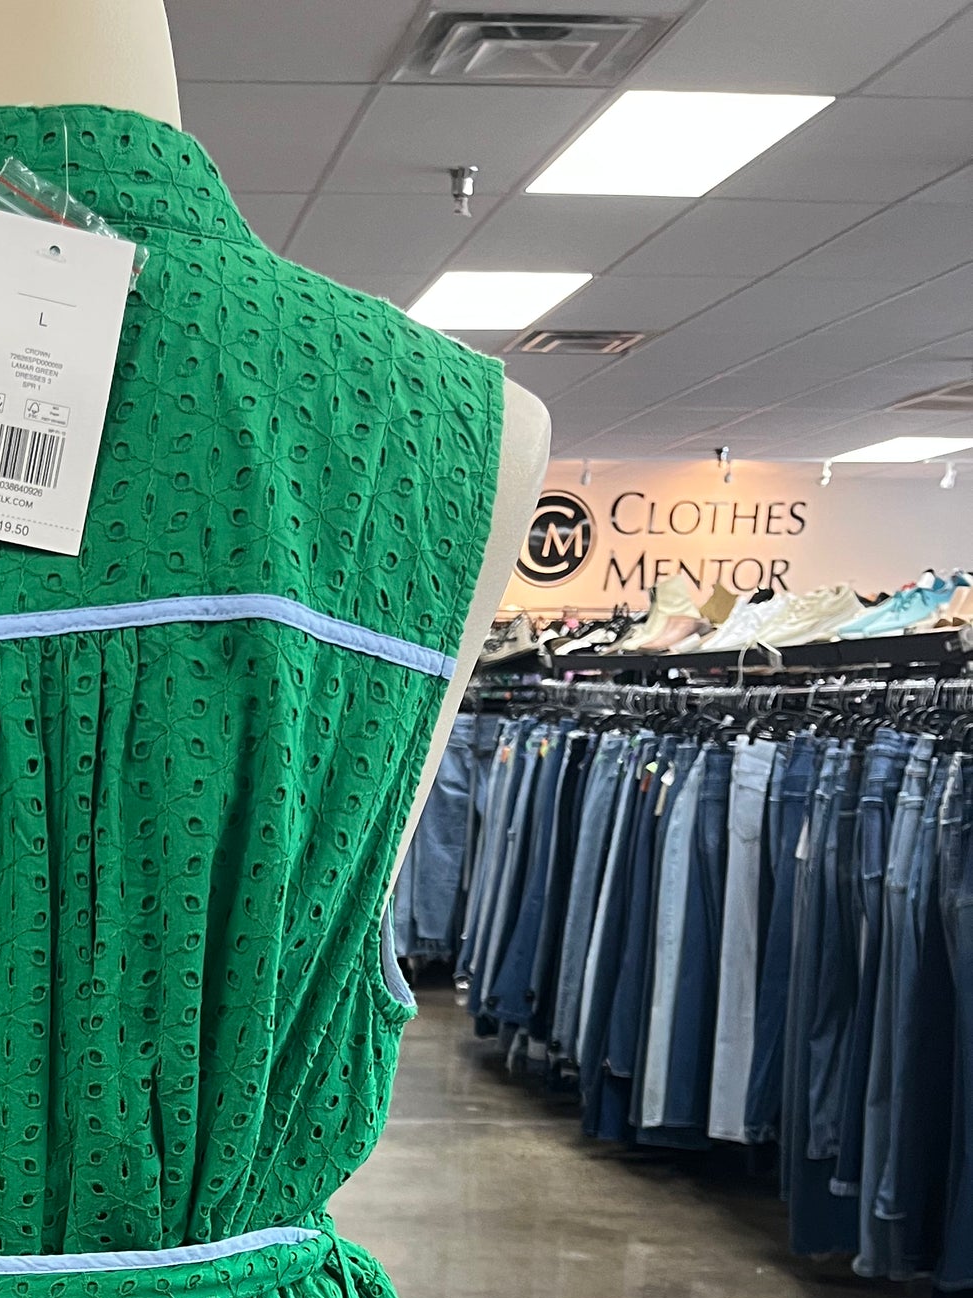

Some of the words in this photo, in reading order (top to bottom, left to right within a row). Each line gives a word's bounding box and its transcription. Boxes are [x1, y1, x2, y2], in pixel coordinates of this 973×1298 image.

[39, 312, 48, 327] L
[25, 347, 51, 359] CROWN
[11, 361, 34, 372] LAMAR
[35, 366, 59, 378] GREEN
[15, 371, 46, 384] DRESSES
